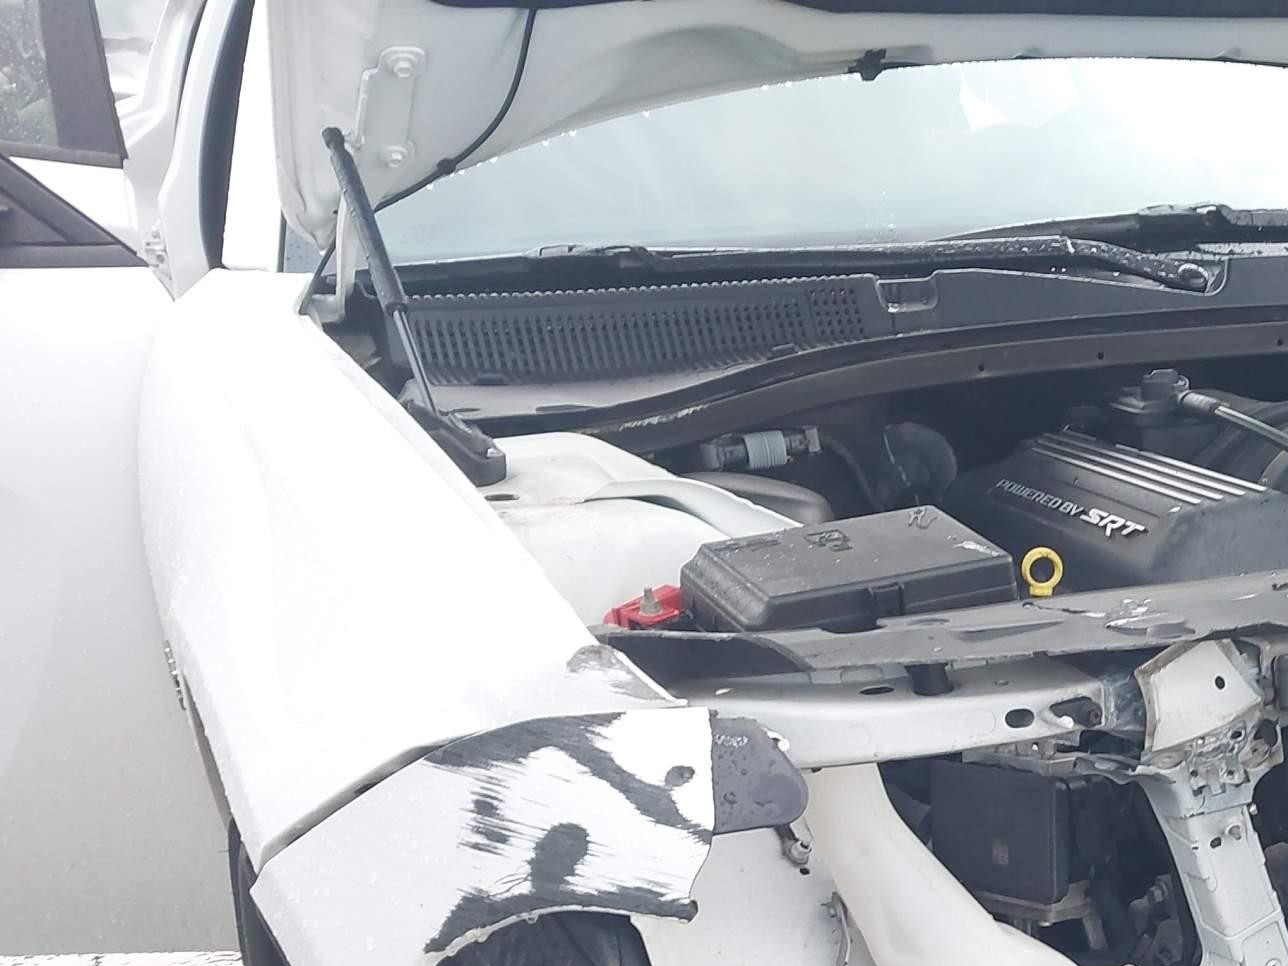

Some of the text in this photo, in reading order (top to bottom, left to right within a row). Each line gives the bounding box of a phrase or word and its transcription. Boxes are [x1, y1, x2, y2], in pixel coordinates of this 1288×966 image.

[996, 478, 1145, 536] POWERED BY SRT
